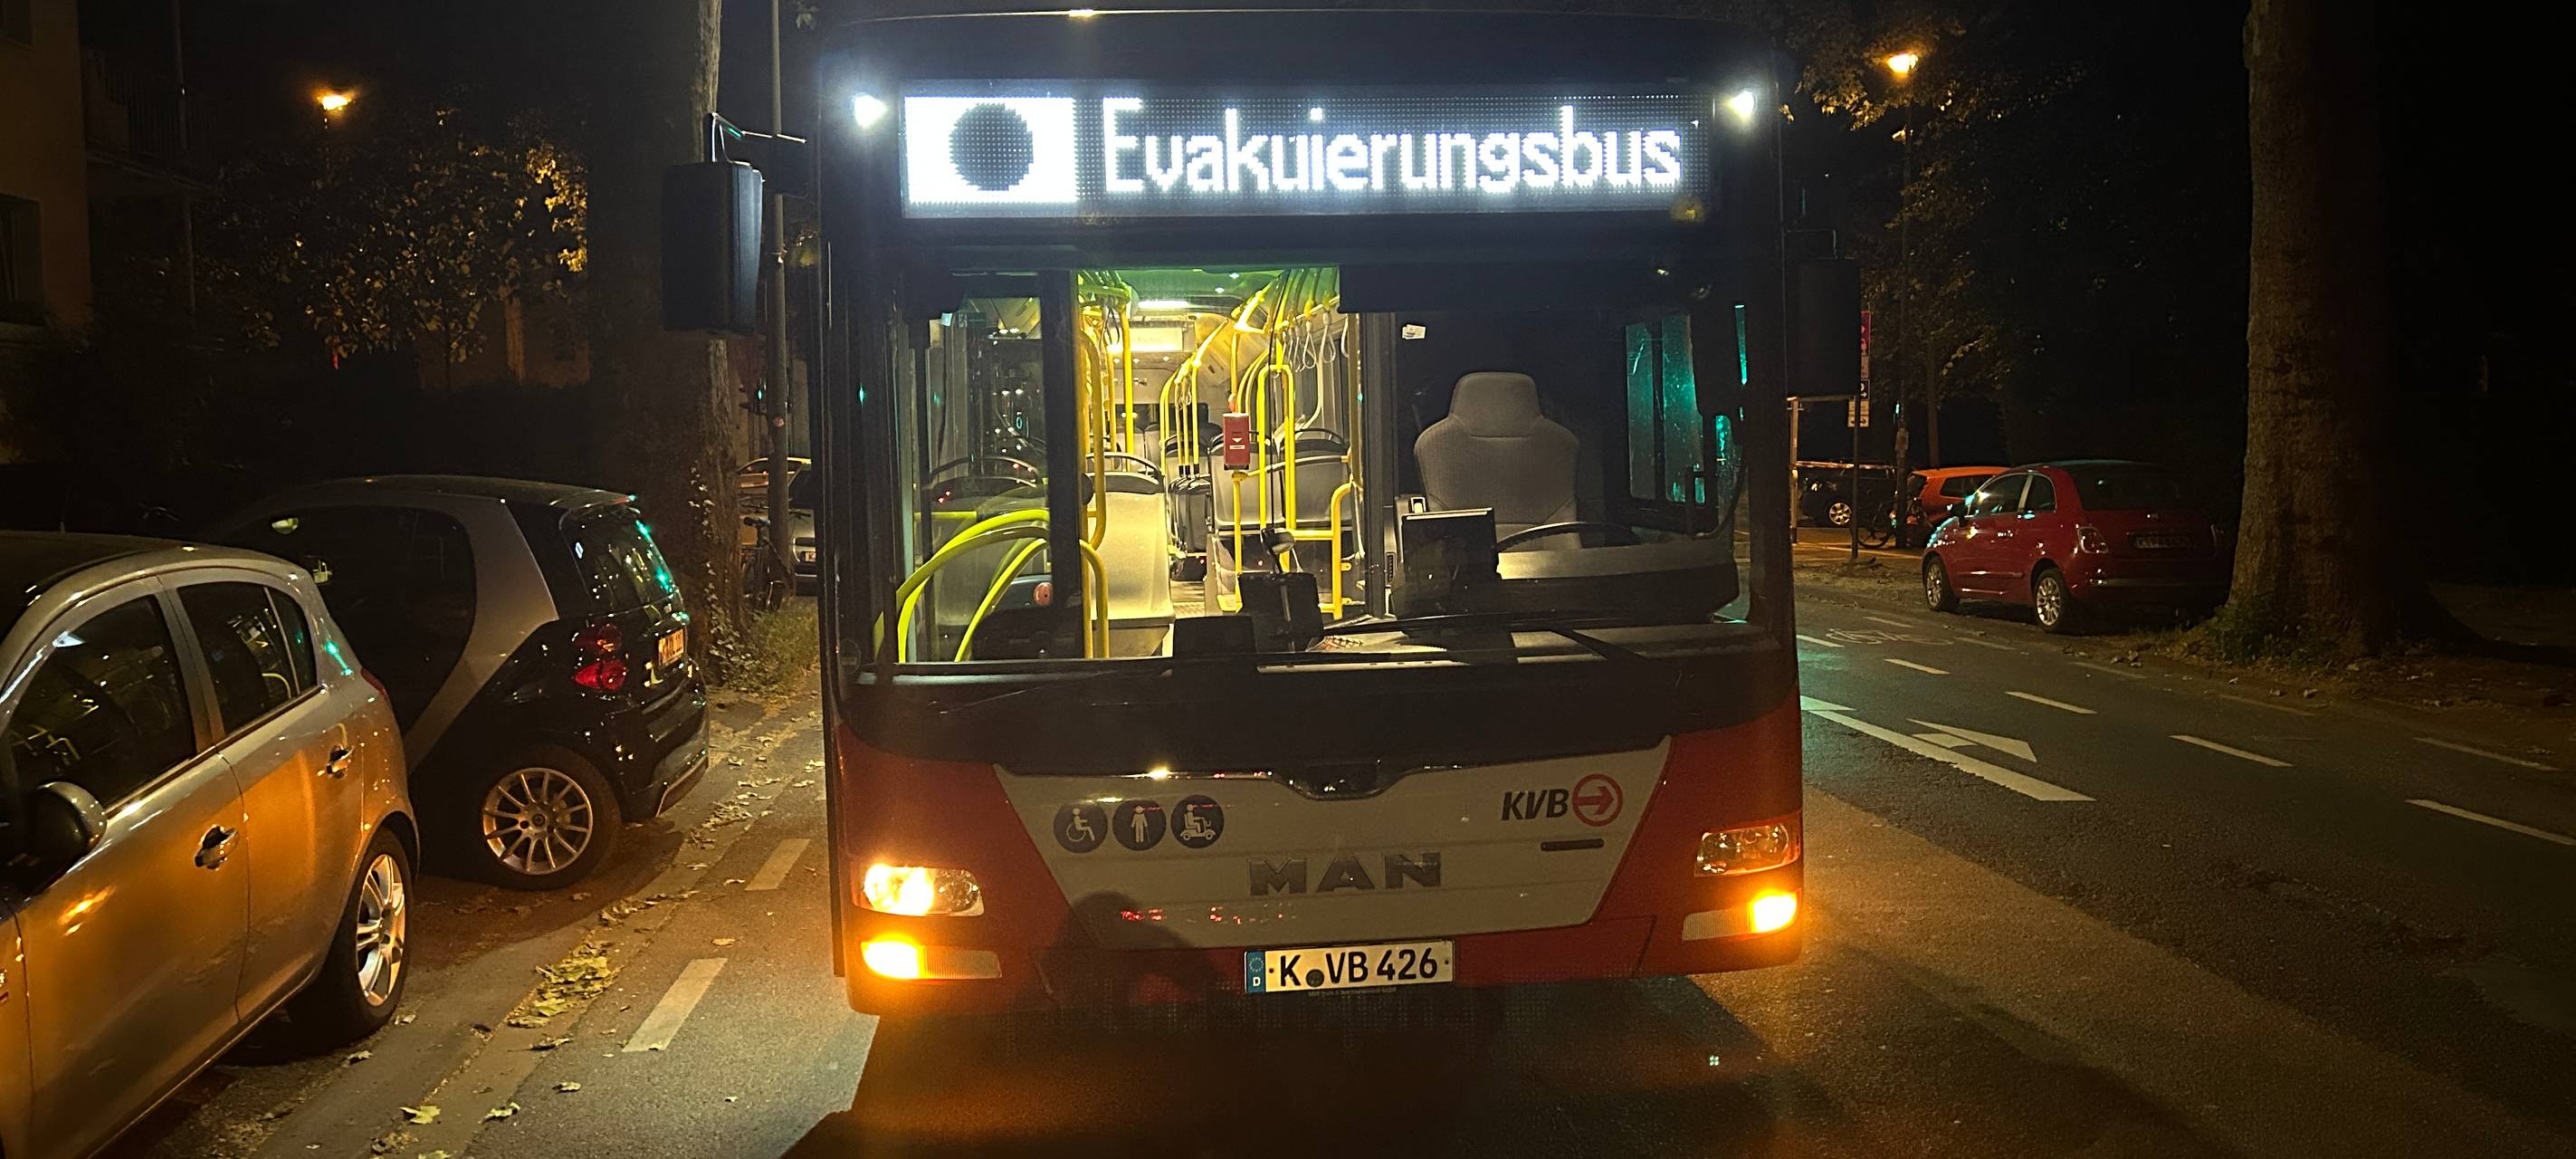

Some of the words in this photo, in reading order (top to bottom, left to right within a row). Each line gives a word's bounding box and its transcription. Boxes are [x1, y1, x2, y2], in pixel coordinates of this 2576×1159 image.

[1102, 97, 1682, 194] Evakuierungsbus
[1501, 788, 1569, 821] KVB
[1249, 852, 1442, 896] MAN
[1376, 947, 1438, 982] 426
